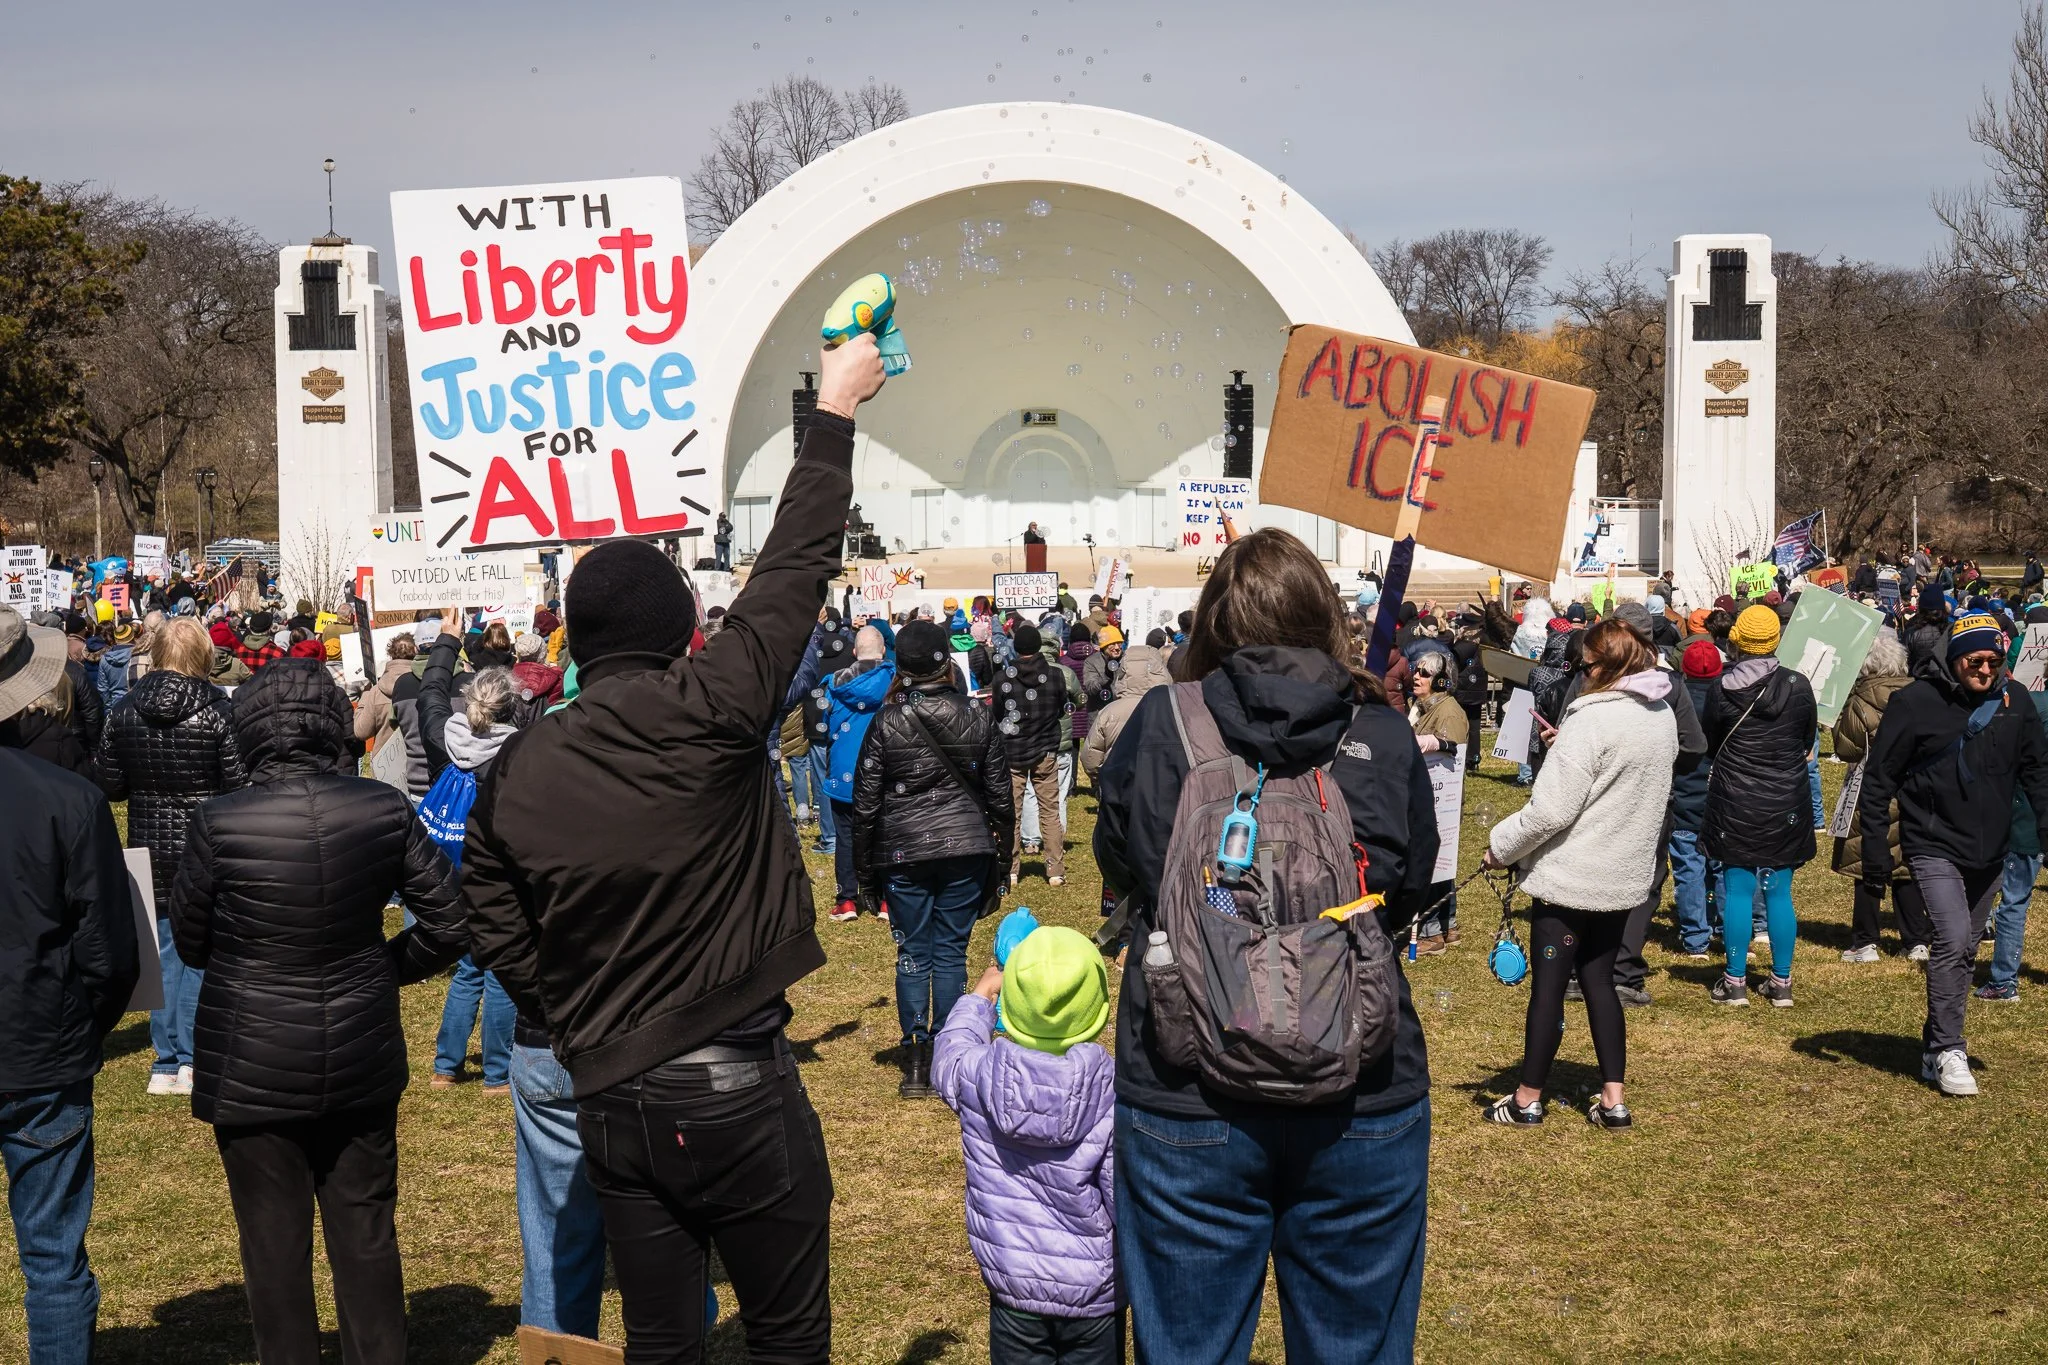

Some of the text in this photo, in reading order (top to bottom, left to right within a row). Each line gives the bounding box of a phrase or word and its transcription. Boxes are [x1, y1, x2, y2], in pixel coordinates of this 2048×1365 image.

[457, 193, 612, 230] WITH
[410, 227, 689, 345] Liberty
[501, 322, 581, 353] AND
[420, 350, 697, 440] Justice
[1297, 335, 1540, 449] ABOLISH
[523, 426, 597, 460] FOR
[1347, 417, 1453, 512] ICE
[1179, 482, 1250, 495] A REPUBLIC,
[470, 449, 688, 544] ALL
[1187, 499, 1200, 508] IF
[1223, 500, 1243, 510] CAN
[1186, 513, 1210, 523] KEEP
[386, 520, 424, 543] UNI
[1183, 531, 1201, 547] NO
[12, 549, 33, 557] TRUMP
[8, 559, 37, 567] WITHOUT
[51, 573, 59, 581] FOR
[392, 564, 511, 585] DIVIDED WE FALL
[864, 565, 884, 582] NO
[50, 582, 58, 590] THE
[997, 575, 1054, 586] DEMOCRACY
[10, 584, 23, 594] NO
[399, 585, 505, 605] (nobody voted for this)
[863, 582, 894, 601] KINGS
[1004, 586, 1048, 596] DIES IN
[9, 593, 27, 601] KINGS
[996, 595, 1057, 608] SILENCE
[1963, 618, 1981, 628] Lite
[1346, 750, 1363, 758] FACE
[1493, 747, 1509, 758] FDT
[445, 831, 465, 842] Vote
